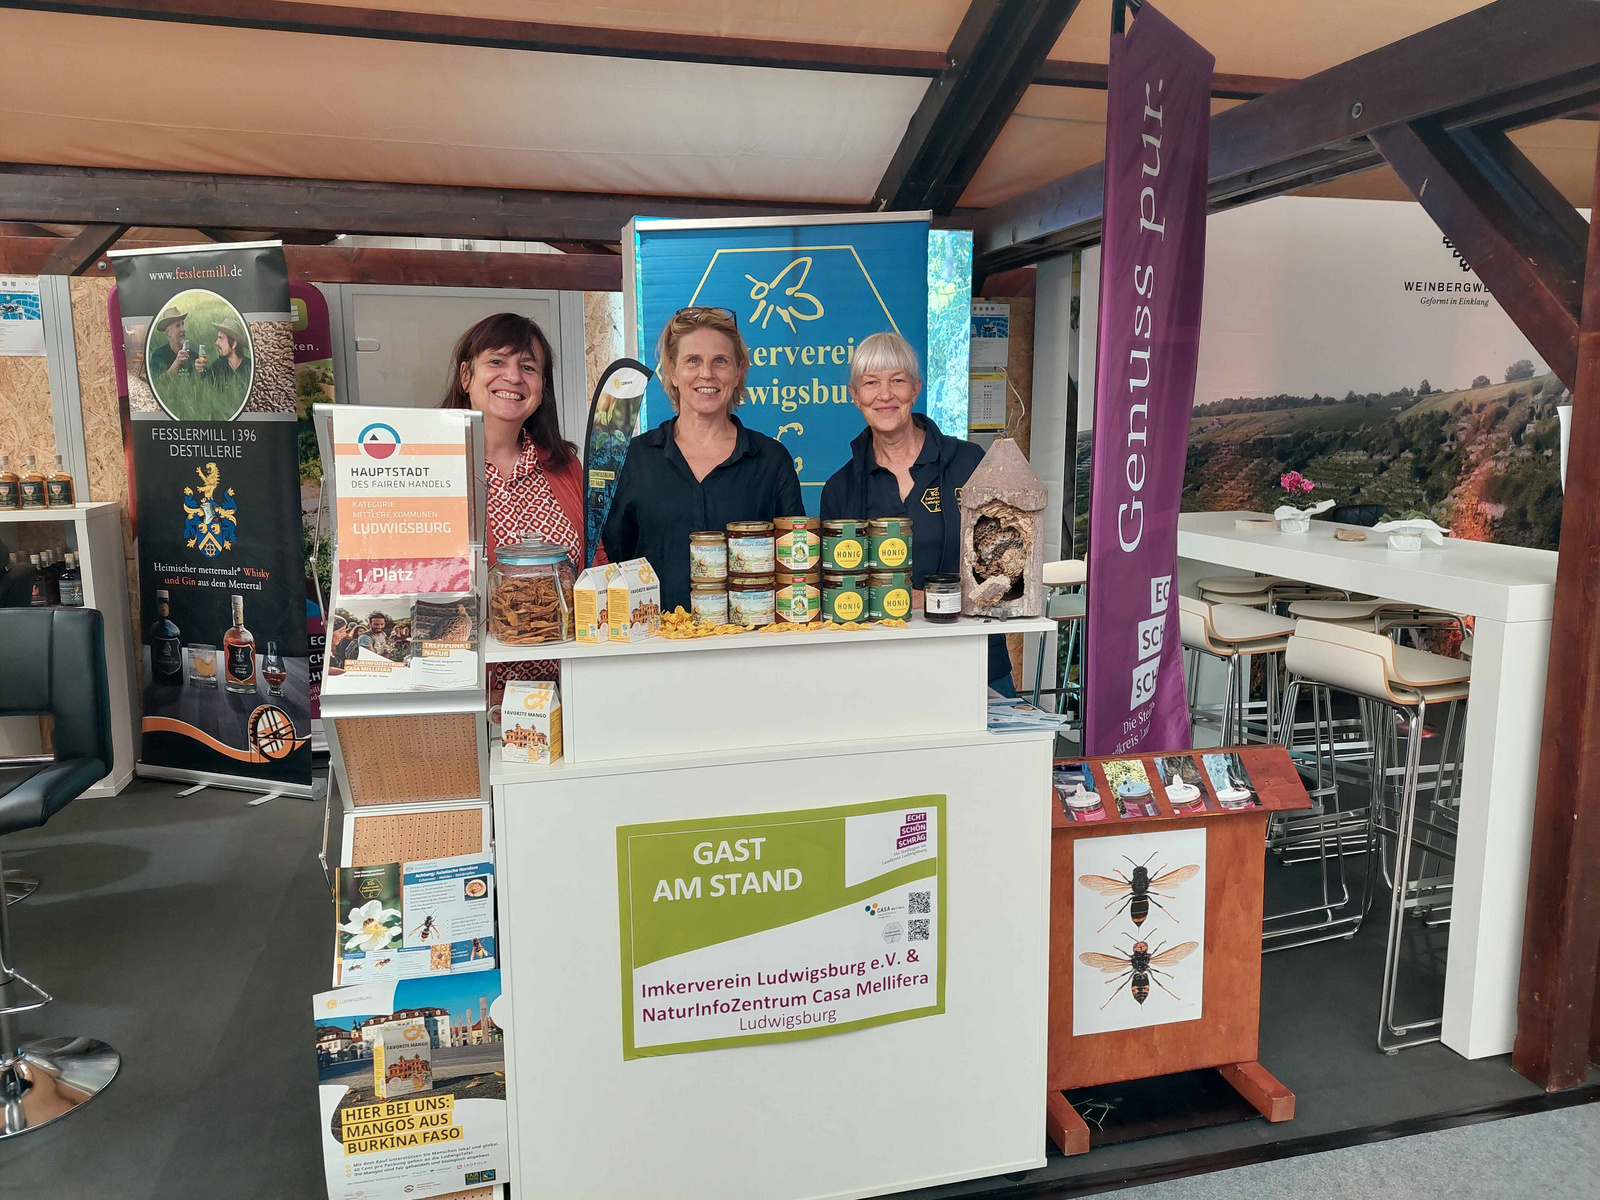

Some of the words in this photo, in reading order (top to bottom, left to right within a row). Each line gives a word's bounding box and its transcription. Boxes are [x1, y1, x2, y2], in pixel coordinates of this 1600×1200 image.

[149, 264, 243, 281] www.fesslermill.de
[1420, 296, 1449, 307] Geformt
[1450, 297, 1457, 305] in
[1458, 297, 1490, 308] Einklang
[1118, 263, 1155, 553] Genuss
[1139, 78, 1166, 242] pur.
[151, 427, 229, 443] FESSLERMILL
[231, 428, 257, 443] 1396
[169, 444, 243, 459] DESTILLERIE
[350, 467, 430, 477] HAUPTSTADT
[351, 480, 369, 489] DES
[371, 480, 406, 489] FAIREN
[408, 479, 451, 488] HANDELS
[352, 511, 391, 519] MITTLERE
[352, 521, 452, 535] LUDWIGSBURG
[836, 550, 861, 558] HONIG
[881, 548, 905, 556] HONIG
[153, 562, 197, 574] Heimischer
[242, 567, 271, 580] Whisky
[355, 568, 368, 582] 1.
[372, 567, 414, 582] Platz
[165, 576, 180, 585] und
[181, 577, 196, 586] Gin
[197, 579, 209, 587] aus
[210, 578, 227, 589] dem
[228, 579, 262, 591] Mettertal
[837, 602, 861, 610] HONIG
[886, 599, 909, 607] HONIG
[906, 813, 926, 822] ECHT
[901, 822, 926, 835] SCHÖN
[898, 832, 926, 848] SCHRÄG
[692, 837, 767, 866] GAST
[652, 876, 702, 903] AM
[709, 868, 803, 898] STAND
[877, 906, 891, 914] CASA
[641, 971, 751, 999] Imkerverein
[757, 960, 866, 985] Ludwigsburg
[870, 952, 901, 970] e.V.
[906, 948, 920, 964] &
[641, 995, 807, 1023] NaturInfoZentrum
[812, 987, 851, 1004] Casa
[856, 973, 930, 998] Mellifera
[739, 1007, 837, 1032] Ludwigsburg
[386, 1043, 410, 1051] FAVORITE
[345, 1107, 382, 1122] HIER
[386, 1102, 411, 1116] BEI
[414, 1097, 450, 1112] UNS:
[346, 1117, 415, 1139] MANGOS
[419, 1113, 449, 1128] AUS
[347, 1134, 419, 1154] BURKINA
[422, 1127, 461, 1143] FASO
[388, 1153, 422, 1163] unterstützen
[431, 1147, 457, 1156] Menschen
[363, 1168, 384, 1177] Mangos
[405, 1161, 430, 1171] gehandelt
[441, 1155, 466, 1165] biologisch
[374, 1163, 384, 1171] pro
[384, 1160, 406, 1169] Packung
[406, 1157, 424, 1166] gehen
[463, 1160, 488, 1168] LEOPOLD
